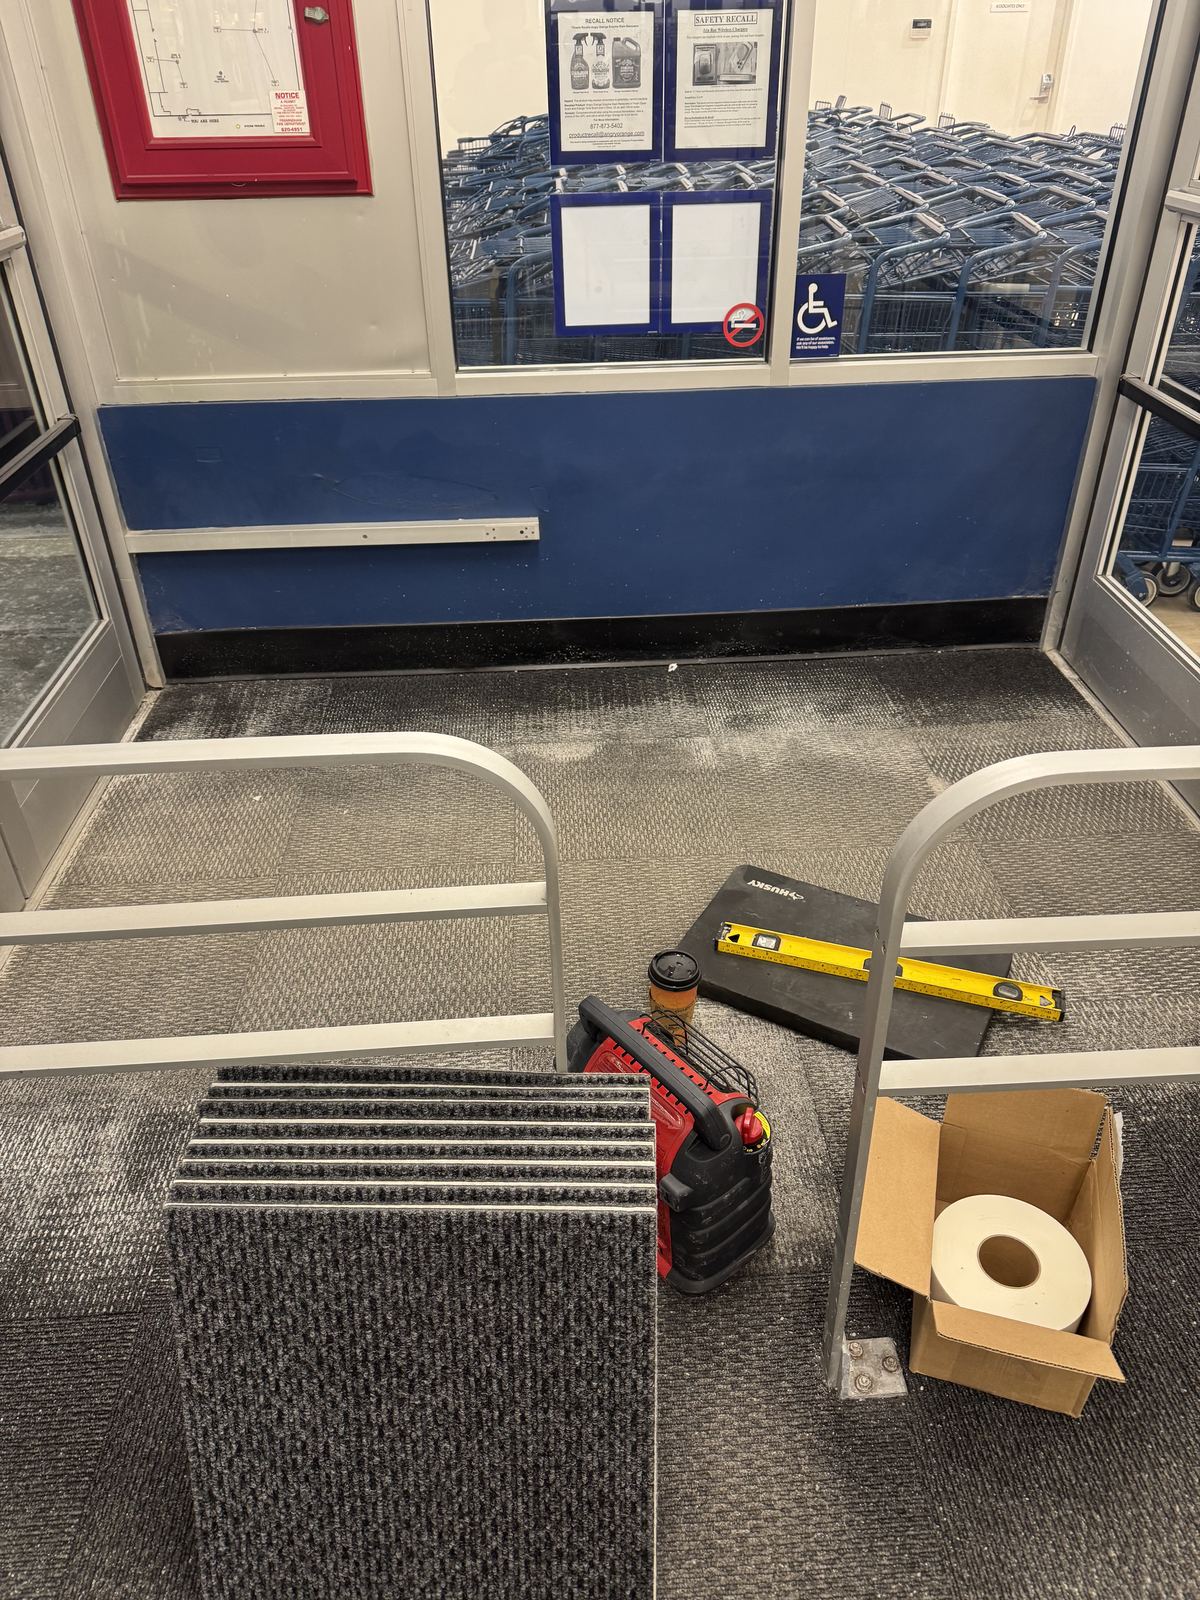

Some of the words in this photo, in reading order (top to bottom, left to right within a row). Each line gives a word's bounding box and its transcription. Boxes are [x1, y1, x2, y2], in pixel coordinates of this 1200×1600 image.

[695, 16, 725, 24] SAFETY
[726, 15, 756, 23] RECALL
[747, 879, 790, 897] HUSKY
